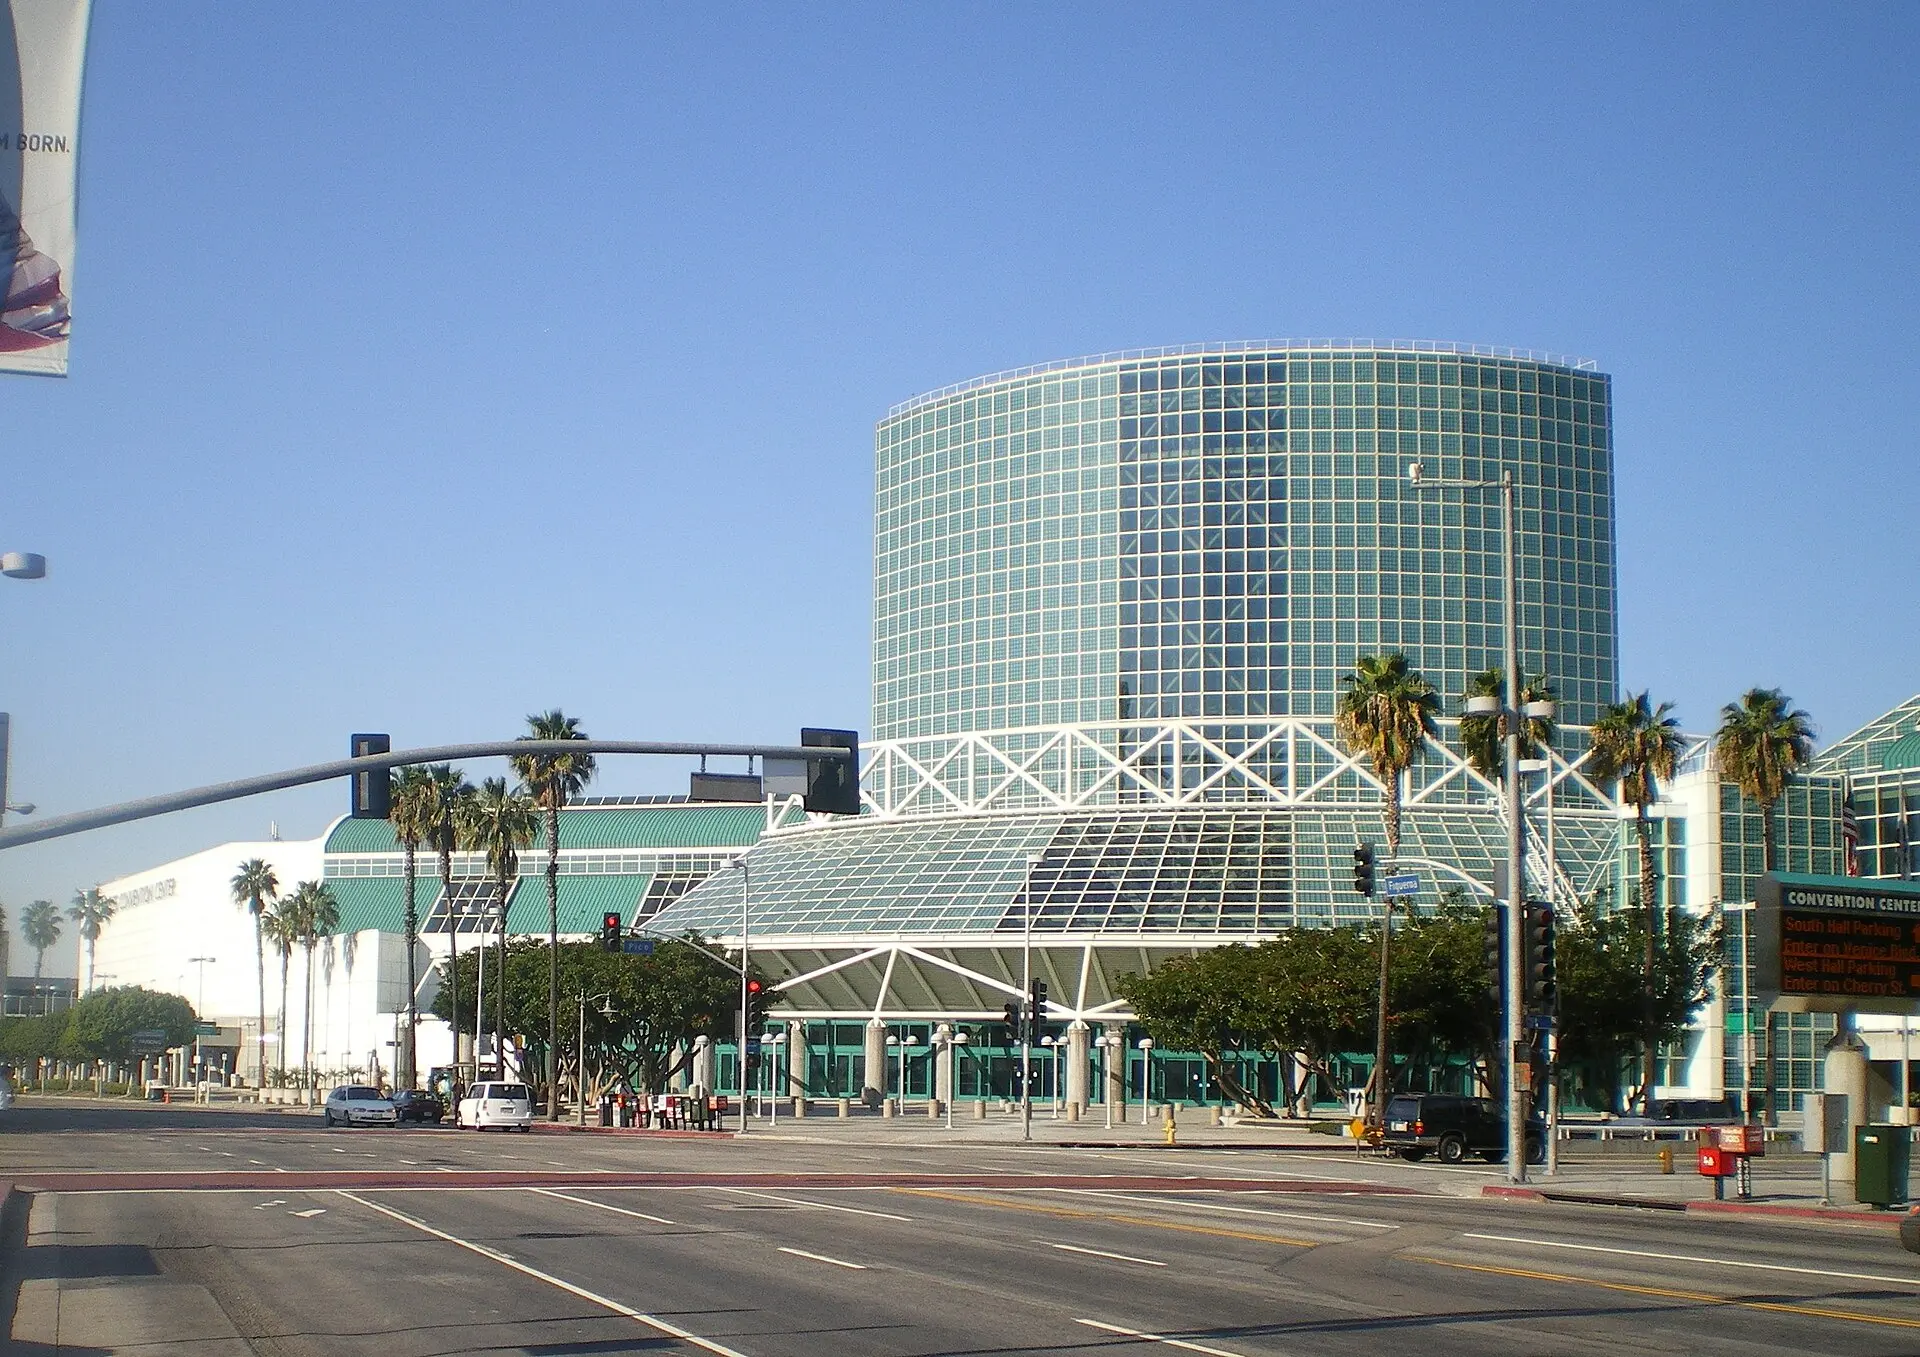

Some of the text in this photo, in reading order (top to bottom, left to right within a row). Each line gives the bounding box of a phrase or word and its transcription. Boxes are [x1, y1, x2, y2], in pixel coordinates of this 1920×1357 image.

[16, 132, 70, 153] BORN.
[1787, 891, 1875, 909] CONVENTION
[1784, 916, 1901, 940] South Hall Parking
[1784, 938, 1818, 954] Enter
[1823, 943, 1840, 955] on
[1783, 956, 1896, 980] West Hall Parking
[1784, 976, 1819, 990] Enter
[1823, 980, 1840, 992] on
[1843, 978, 1888, 996] Cherry
